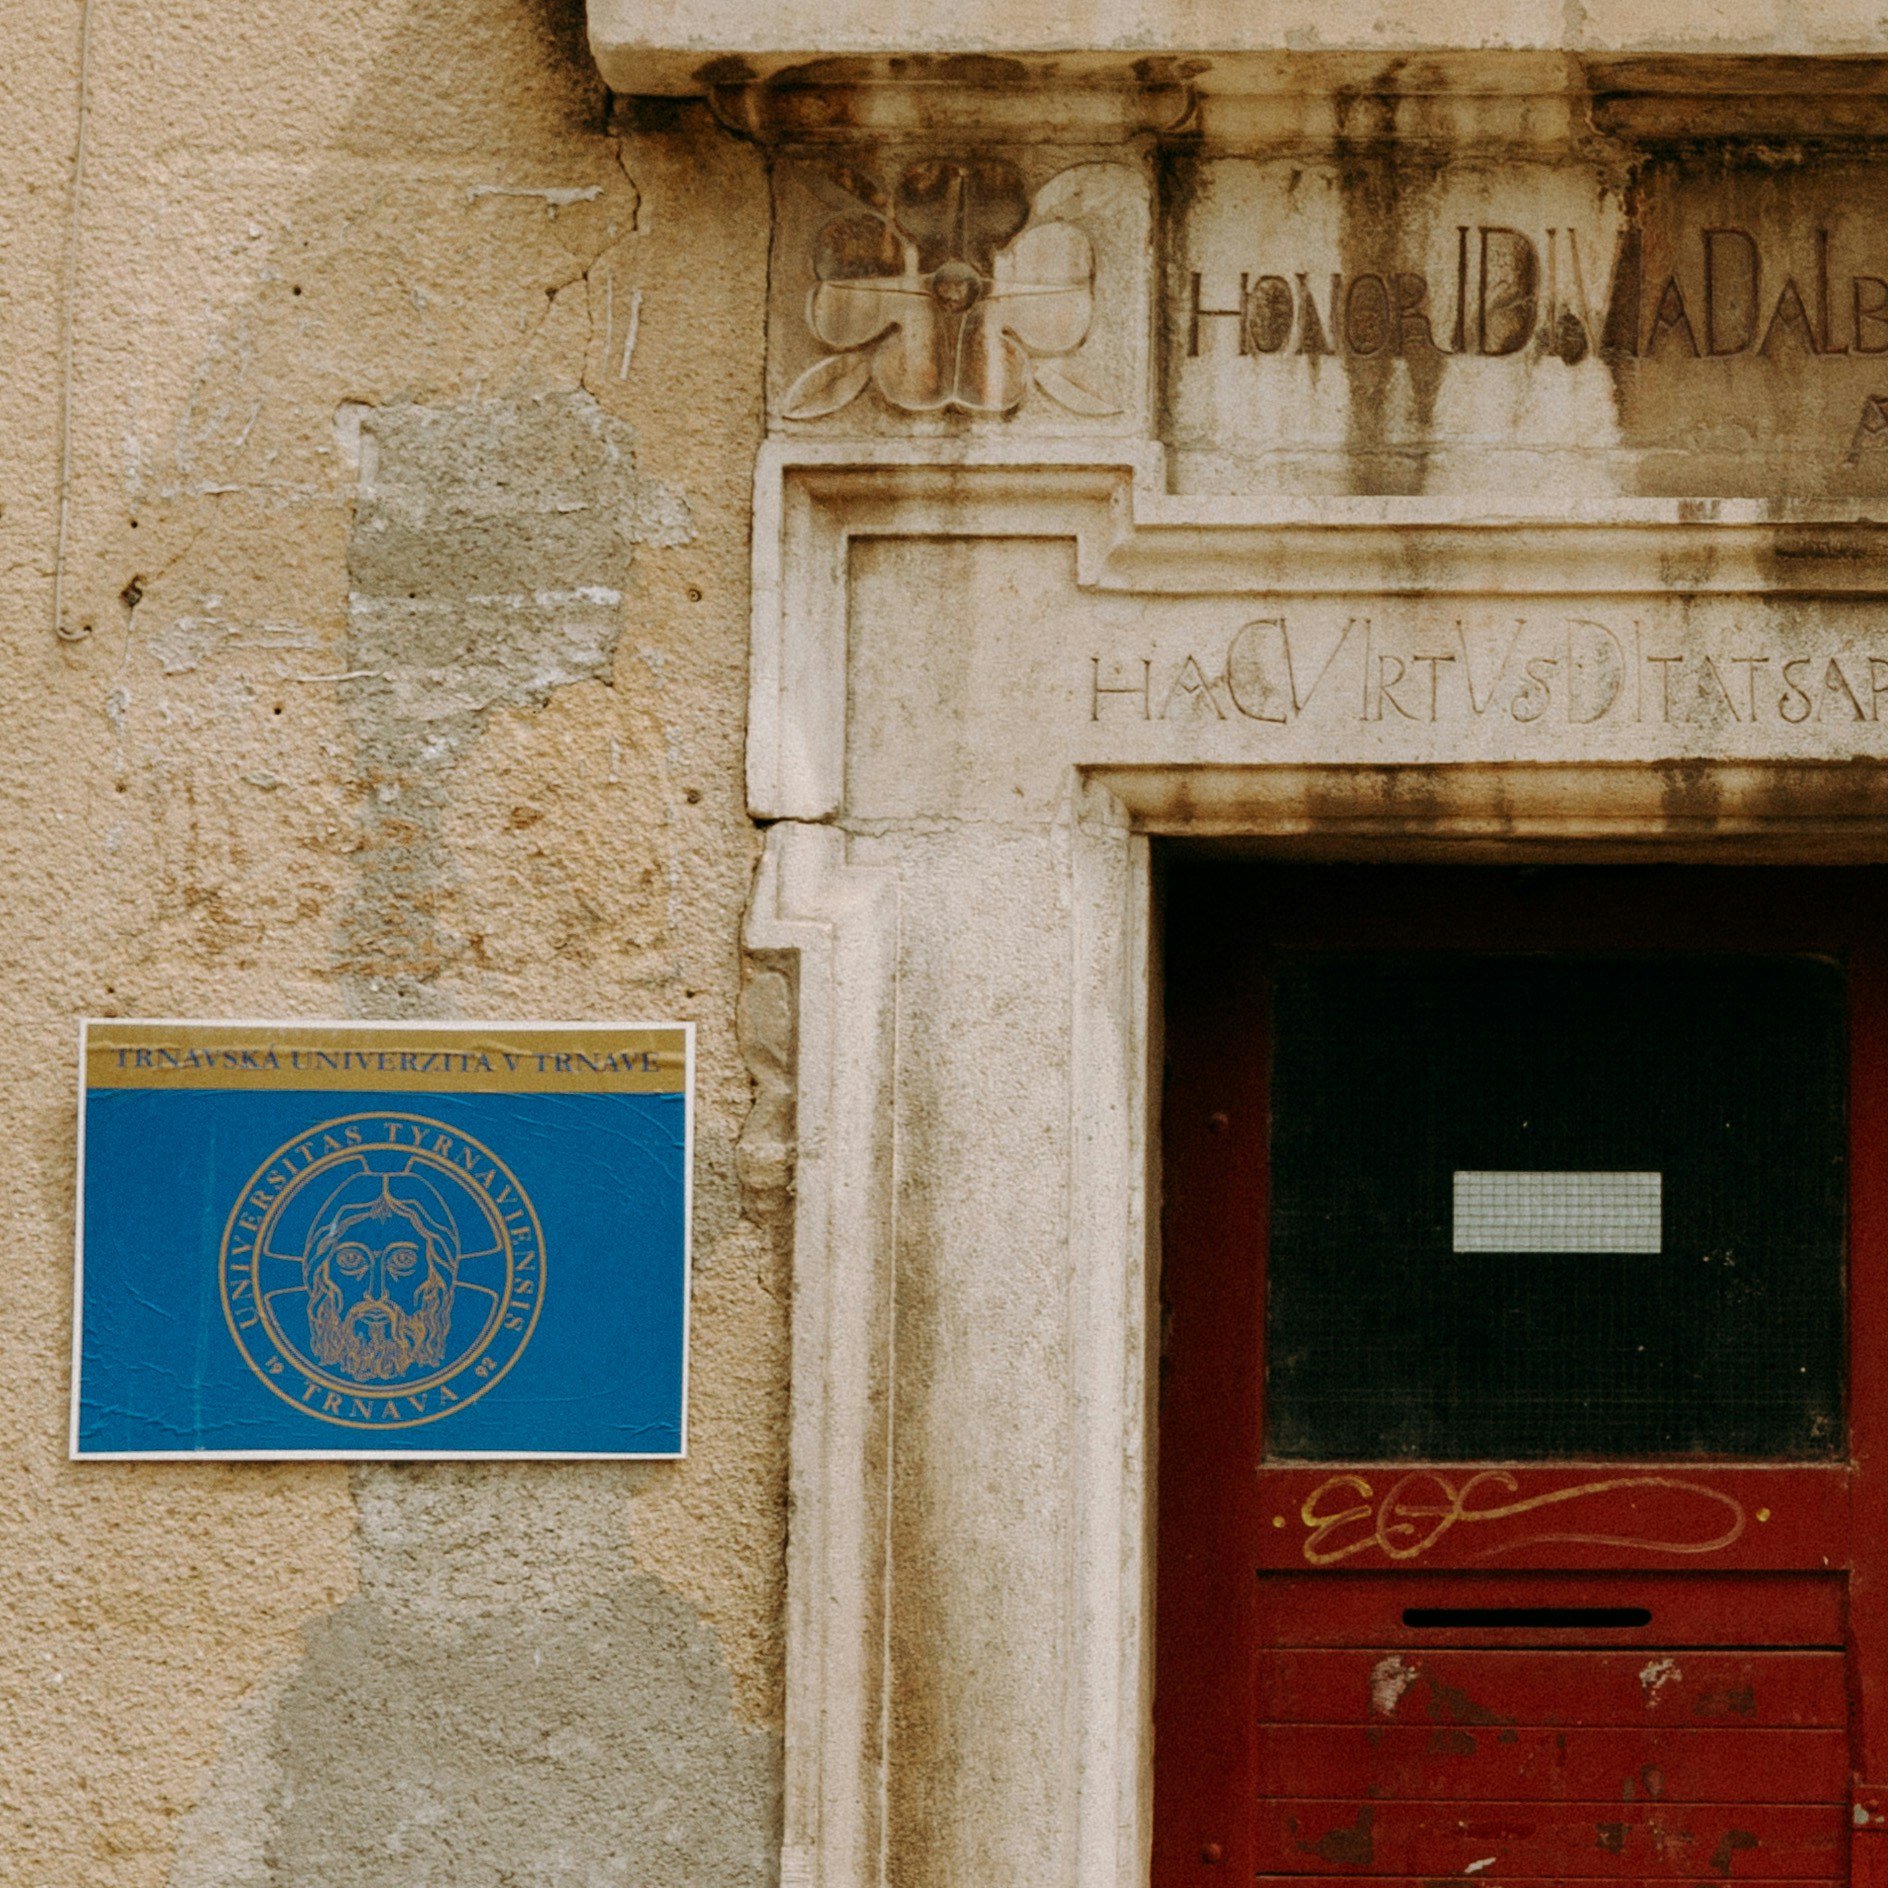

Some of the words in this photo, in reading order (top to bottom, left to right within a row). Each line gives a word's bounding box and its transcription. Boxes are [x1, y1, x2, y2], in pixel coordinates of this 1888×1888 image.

[112, 1044, 280, 1071] TRNAVSKÁ
[291, 1050, 495, 1074] UNIVERZITA
[502, 1052, 524, 1074] V
[532, 1052, 662, 1074] TRNAVE
[229, 1125, 363, 1330] UNIVERSITAS
[384, 1122, 536, 1332] TYRNAVIENSIS
[265, 1355, 285, 1375] 19
[474, 1355, 498, 1378] 92
[301, 1381, 458, 1419] TRNAVA
